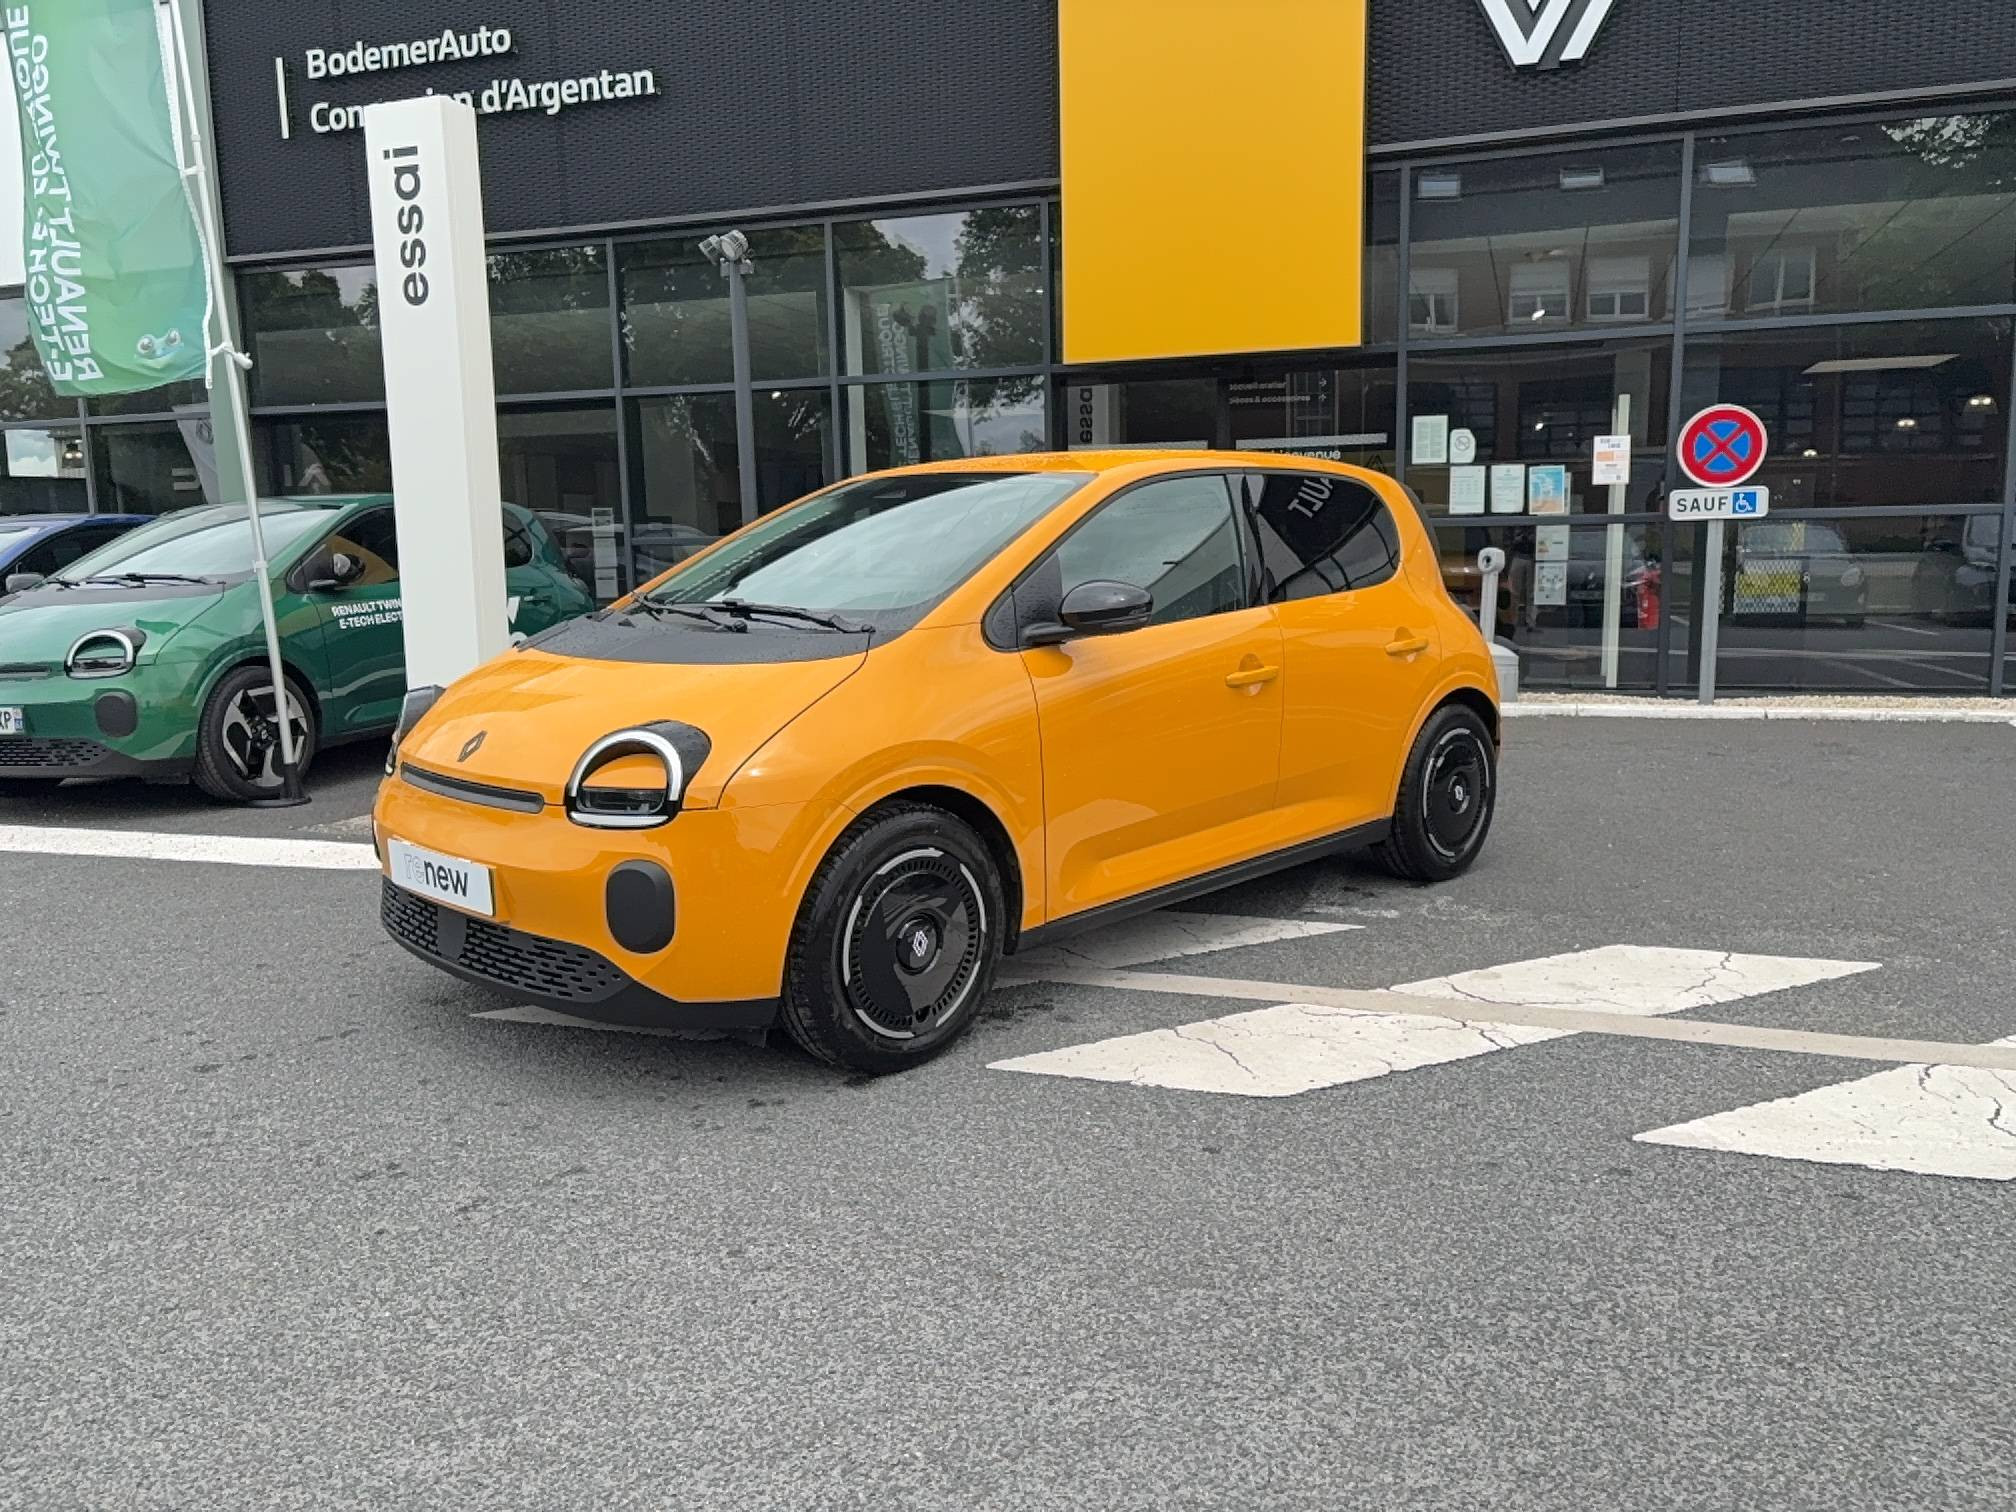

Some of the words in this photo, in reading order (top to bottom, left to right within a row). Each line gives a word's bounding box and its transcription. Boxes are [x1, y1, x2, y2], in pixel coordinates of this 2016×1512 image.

[305, 25, 512, 79] BodemerAuto
[480, 67, 655, 115] d'Argentan
[383, 145, 430, 306] essai
[1676, 496, 1728, 513] SAUF
[331, 601, 377, 617] RENAULT
[375, 598, 402, 611] TWIN
[339, 613, 375, 629] E-TECH
[374, 610, 403, 625] ELECT
